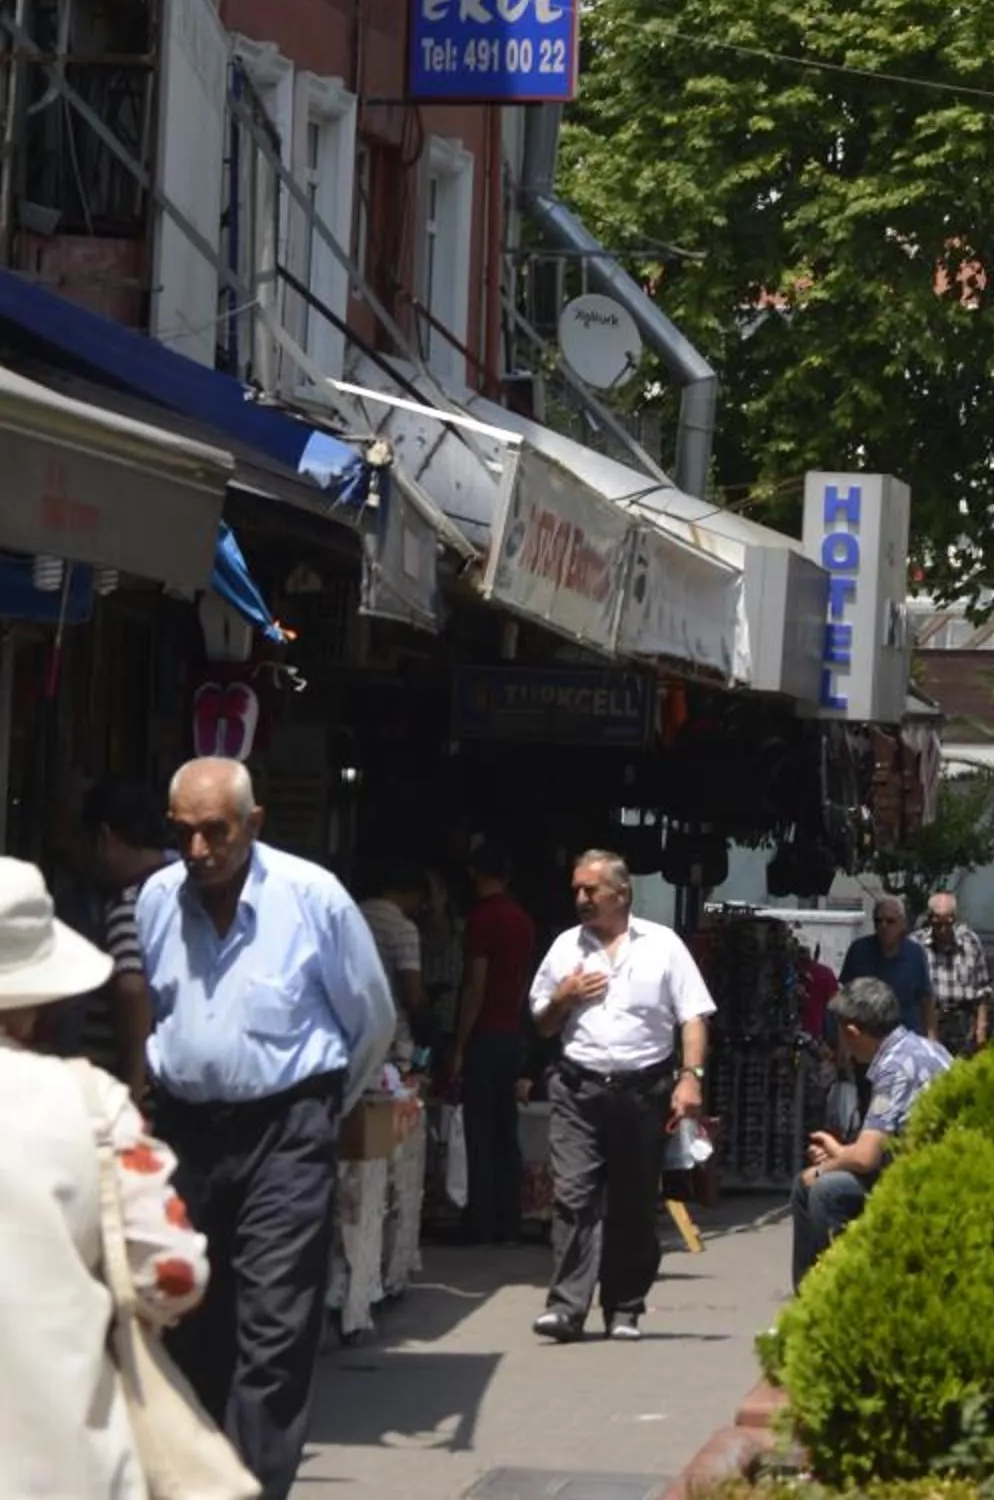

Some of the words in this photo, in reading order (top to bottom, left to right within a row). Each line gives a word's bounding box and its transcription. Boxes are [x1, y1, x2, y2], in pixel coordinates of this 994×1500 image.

[421, 37, 457, 73] Tel:
[463, 38, 500, 73] 491
[505, 38, 533, 73] 00
[538, 38, 566, 74] 22
[820, 484, 862, 710] HOTEL
